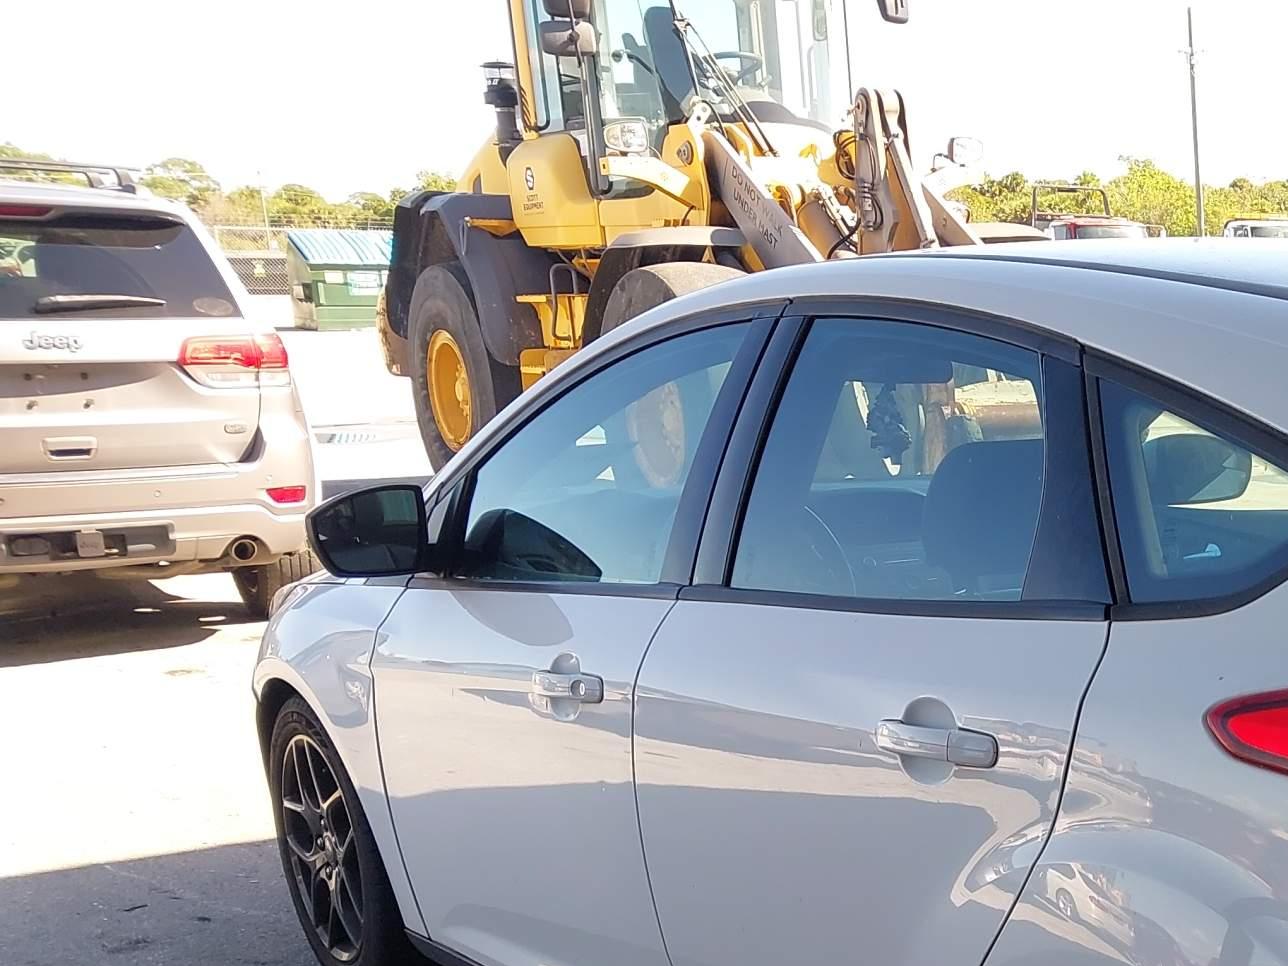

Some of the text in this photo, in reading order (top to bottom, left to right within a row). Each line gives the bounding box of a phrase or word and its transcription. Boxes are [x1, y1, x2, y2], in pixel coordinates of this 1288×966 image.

[731, 165, 783, 237] DO NOT WK
[733, 187, 758, 227] UNDER
[22, 330, 84, 353] Jeep
